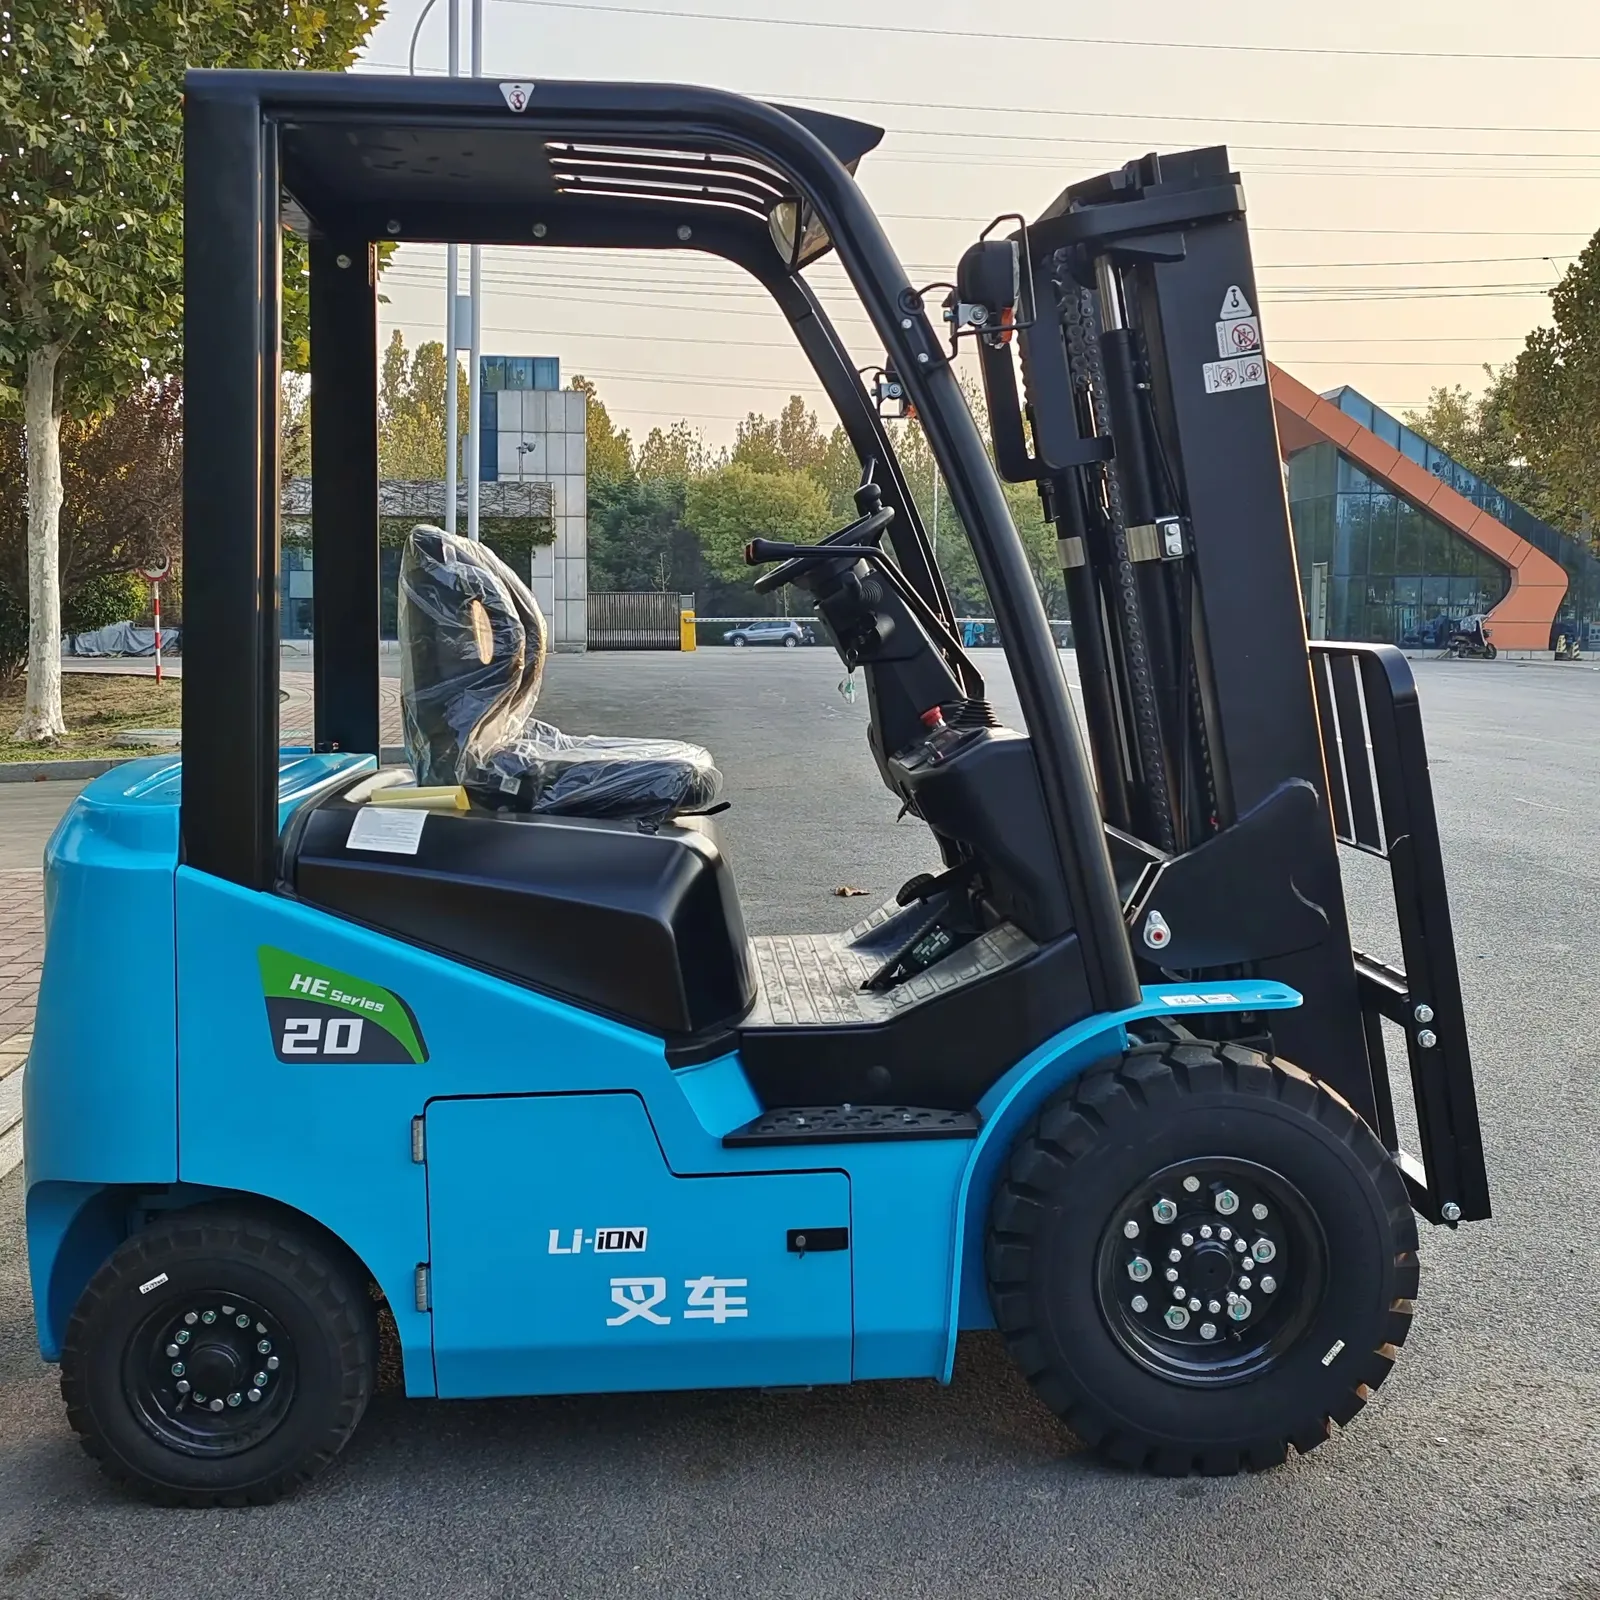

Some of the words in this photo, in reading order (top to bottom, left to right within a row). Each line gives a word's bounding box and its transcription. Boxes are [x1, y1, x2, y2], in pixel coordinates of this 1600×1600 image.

[289, 973, 330, 997] HE
[329, 989, 384, 1012] Series
[281, 1018, 364, 1054] 20
[606, 1276, 748, 1326] 叉车
